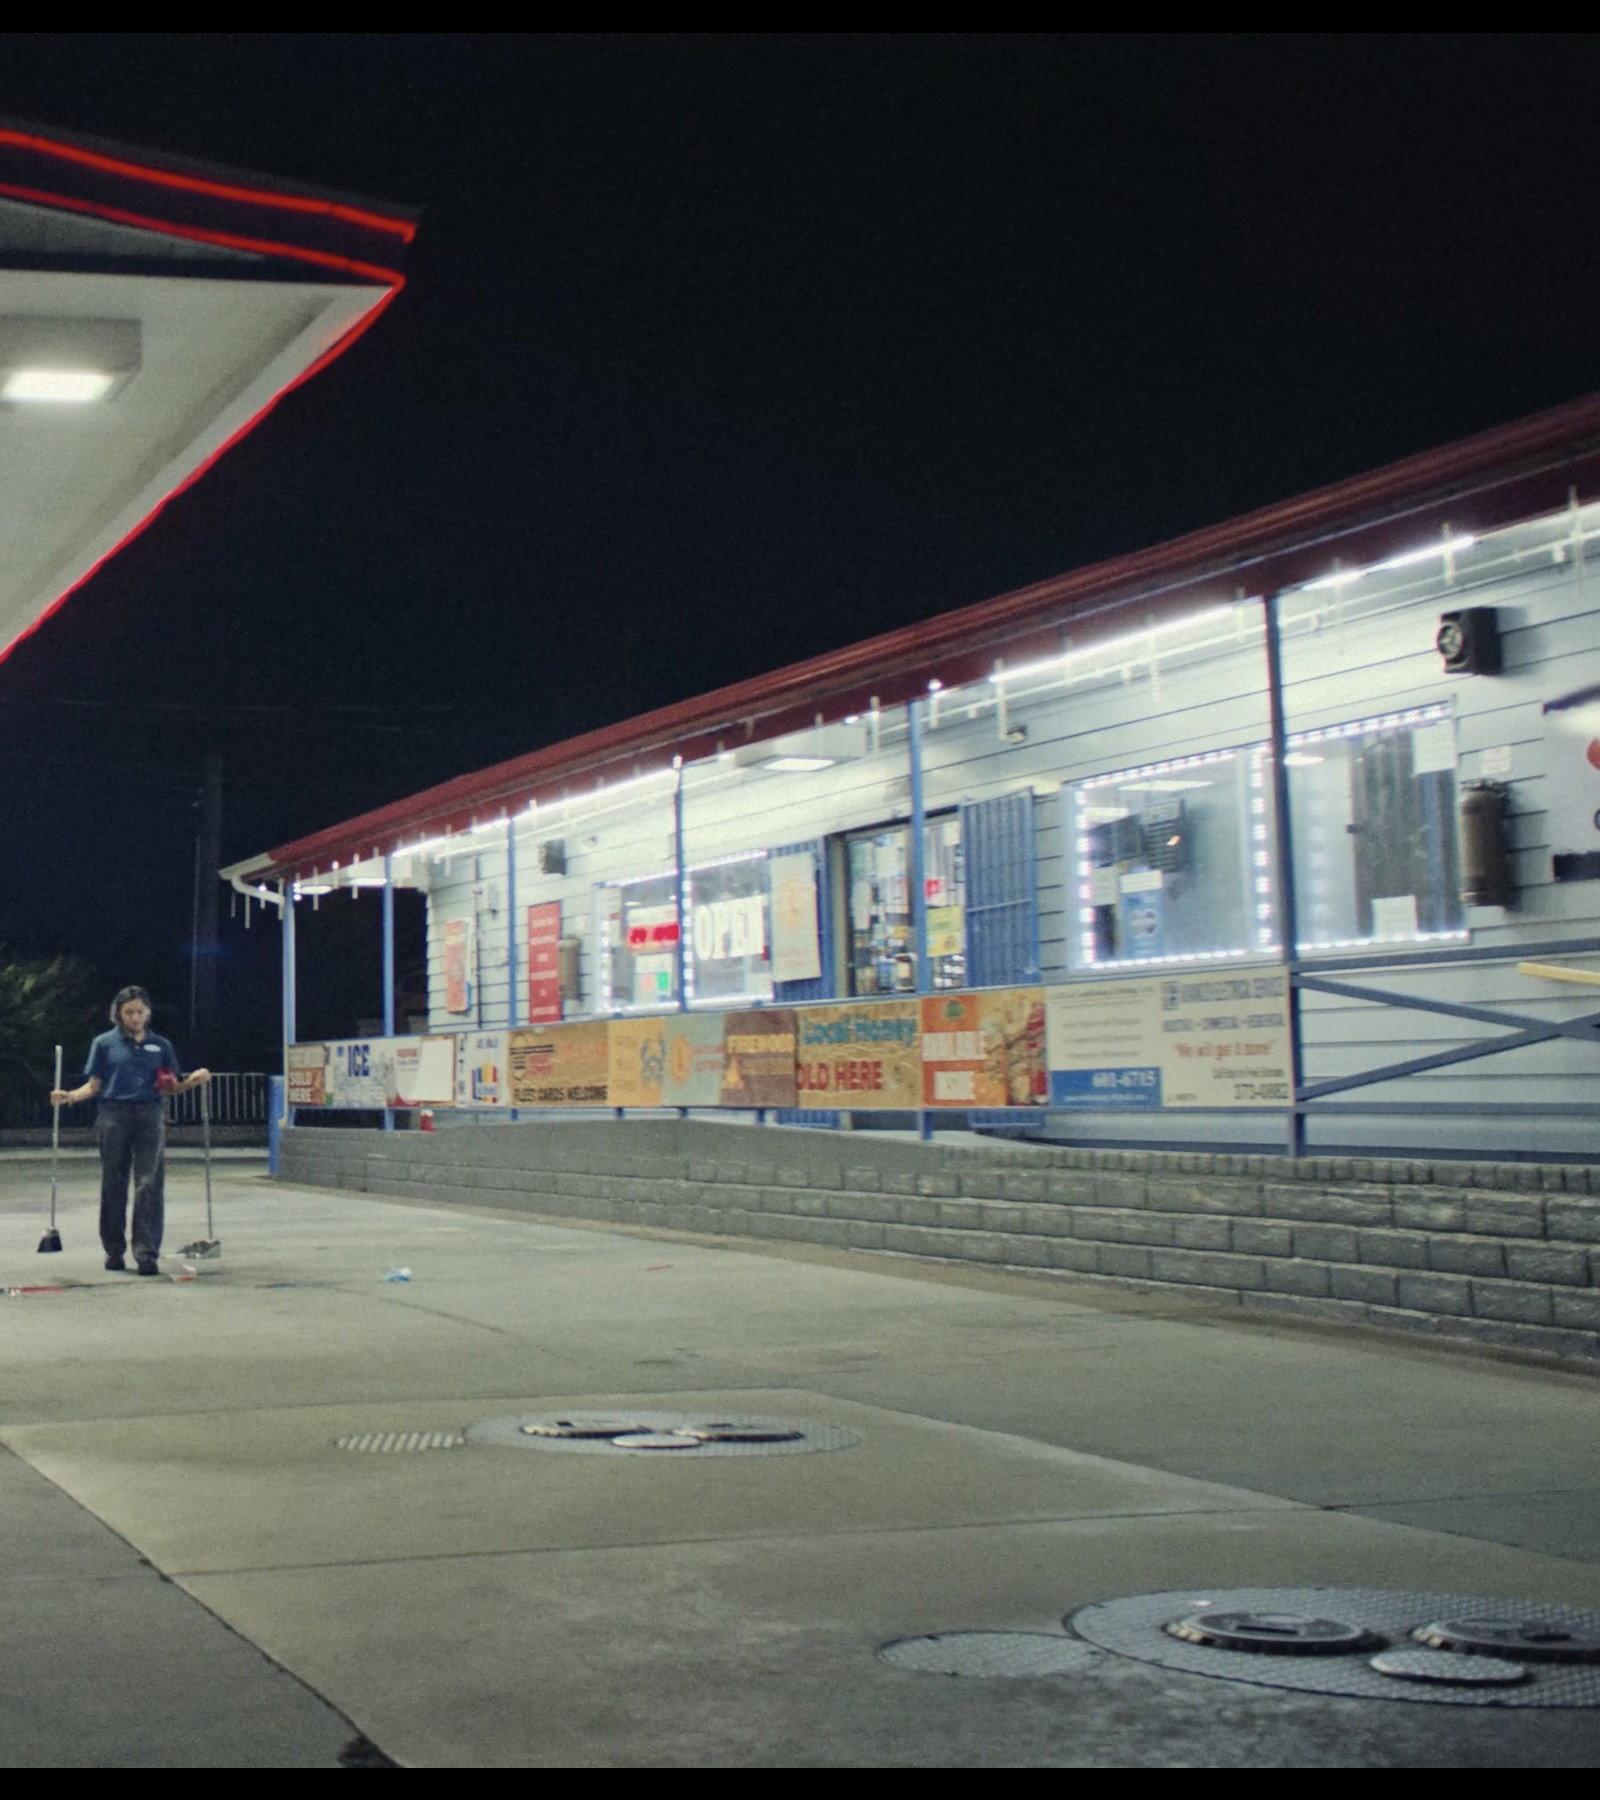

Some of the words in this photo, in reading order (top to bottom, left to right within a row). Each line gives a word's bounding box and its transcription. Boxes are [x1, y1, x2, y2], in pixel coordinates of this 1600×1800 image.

[348, 1044, 370, 1077] ICE
[795, 1062, 829, 1090] OLD
[836, 1061, 883, 1090] HERE
